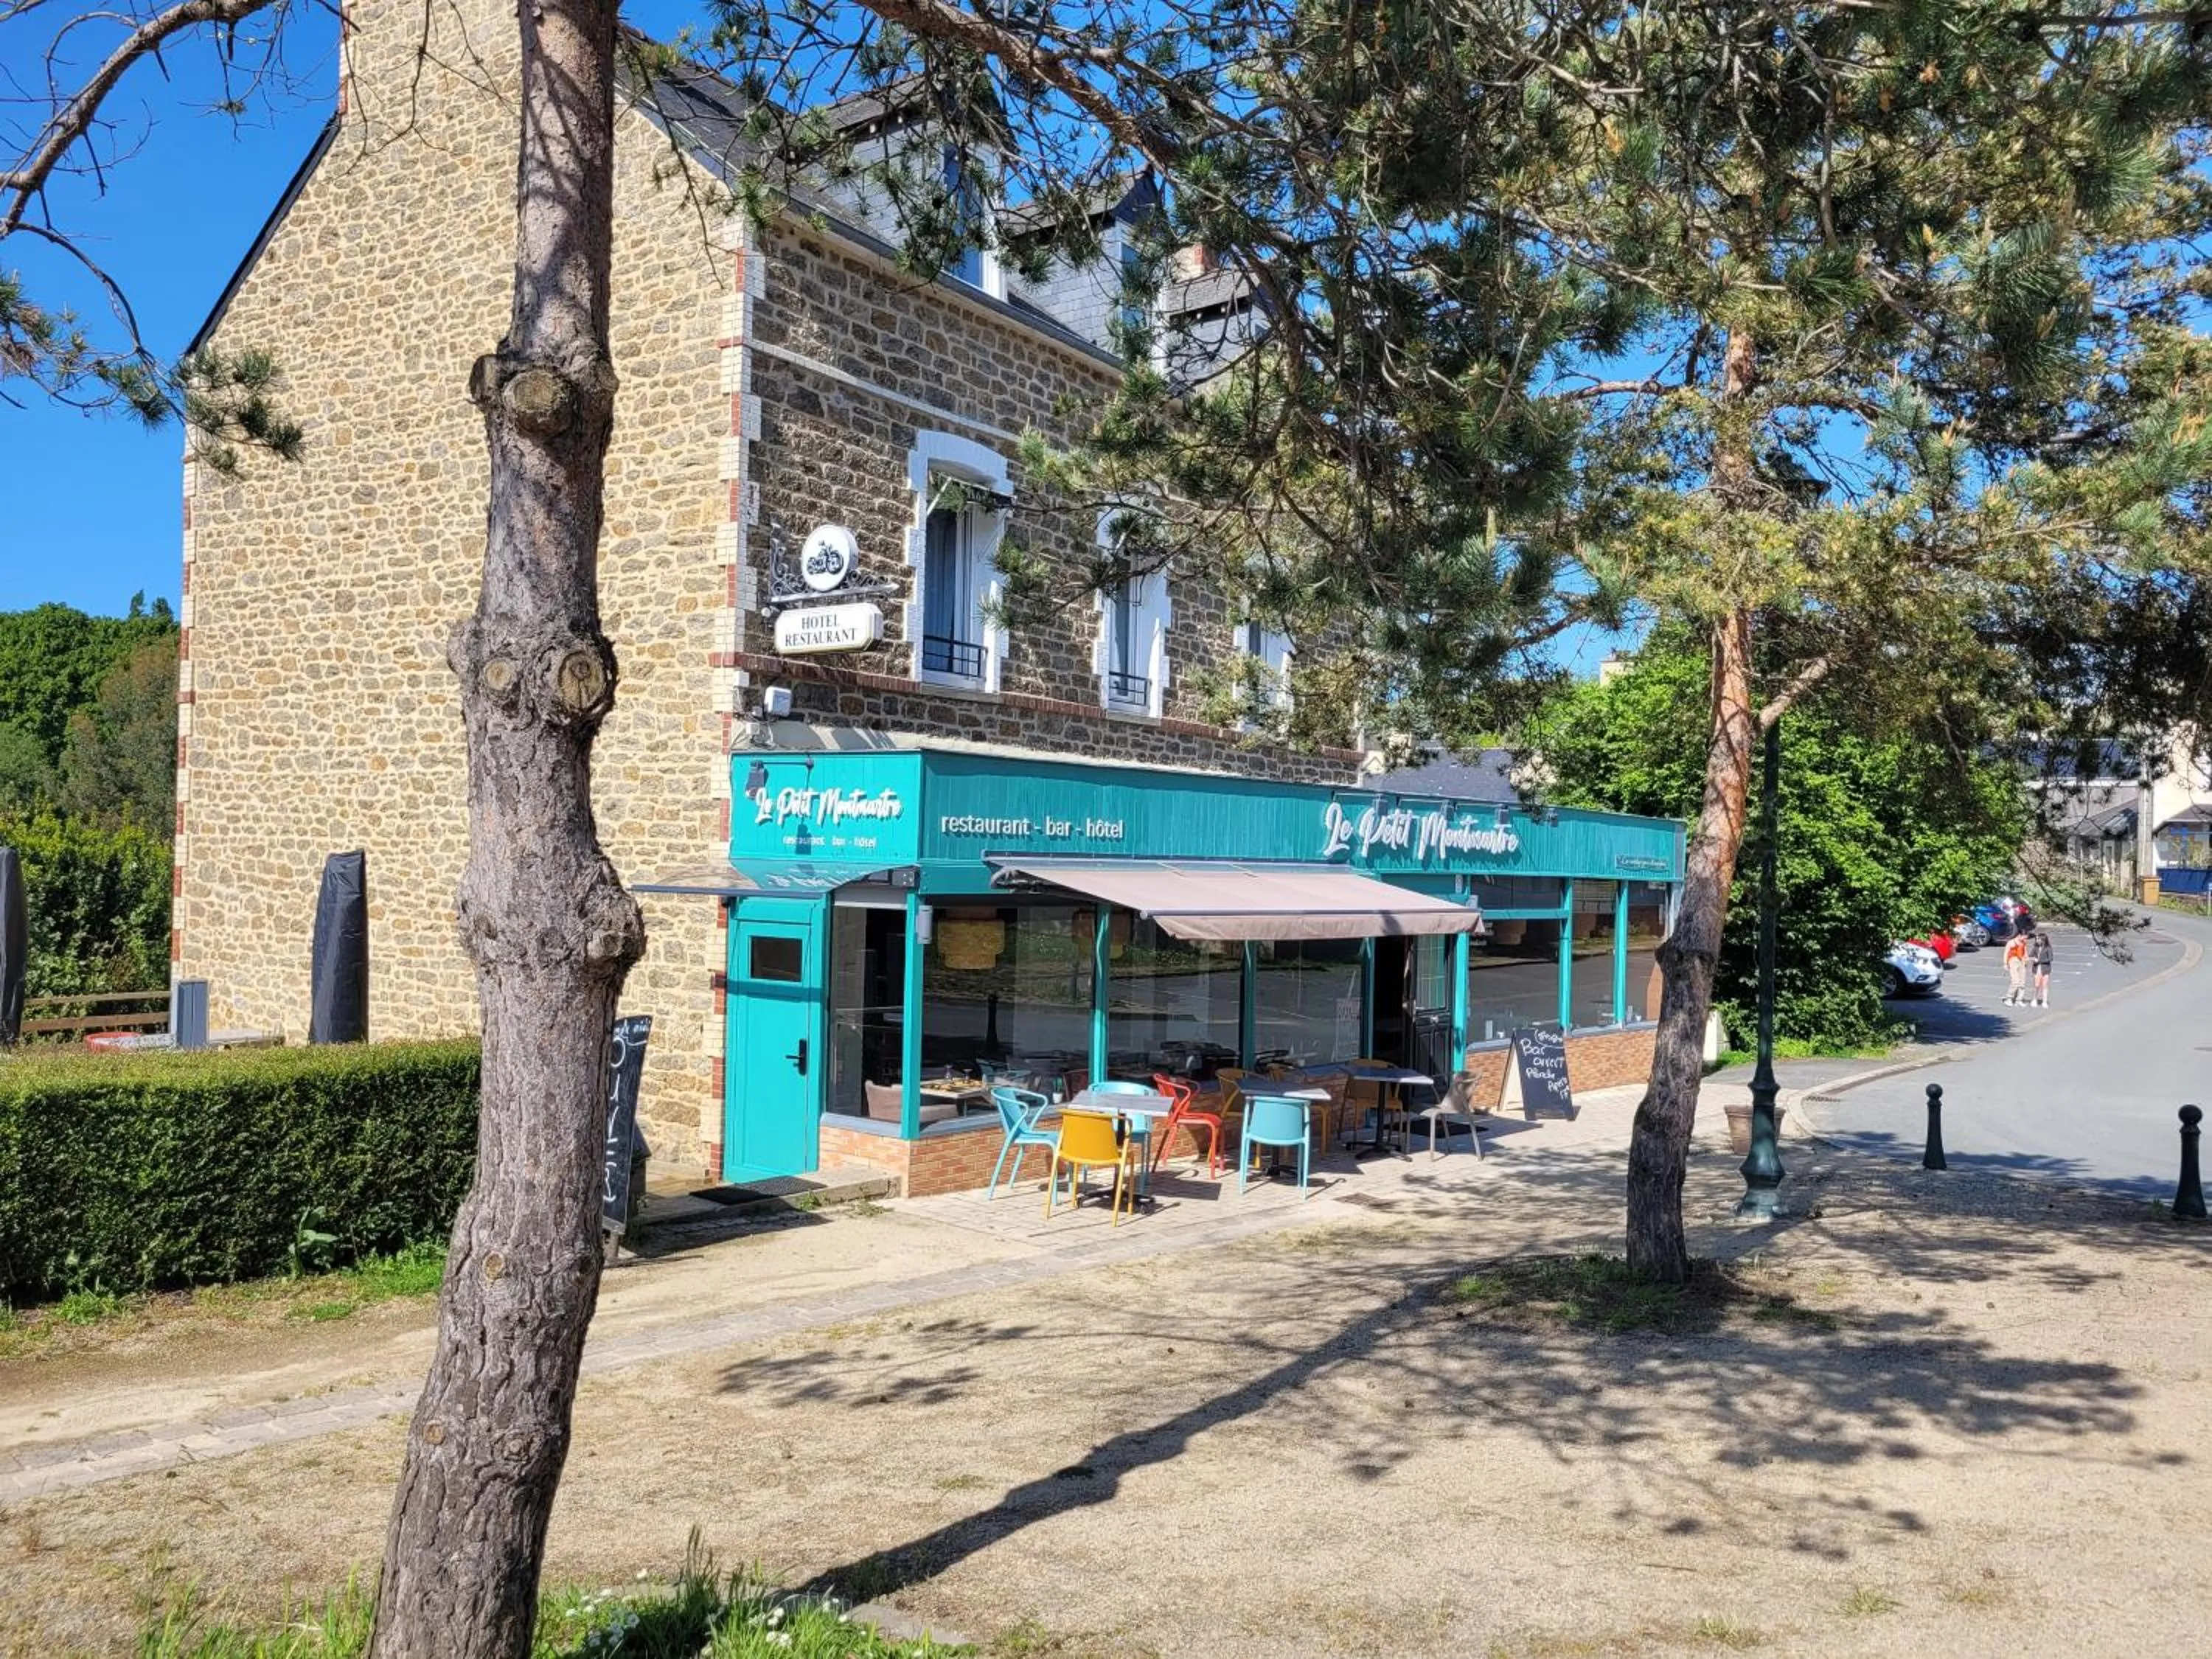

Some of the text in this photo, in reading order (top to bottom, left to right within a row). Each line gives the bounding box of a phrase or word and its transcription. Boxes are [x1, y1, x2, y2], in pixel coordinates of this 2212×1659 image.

[801, 613, 839, 630] HOTEL
[785, 628, 858, 647] RESTAURANT
[755, 787, 902, 826] Le Petit Montmartre
[941, 815, 1031, 835] restaurant
[1046, 815, 1070, 836] bar
[1086, 818, 1123, 839] hôtel
[1324, 801, 1520, 860] Le Petit Montmartre
[1520, 1038, 1545, 1056] Bar
